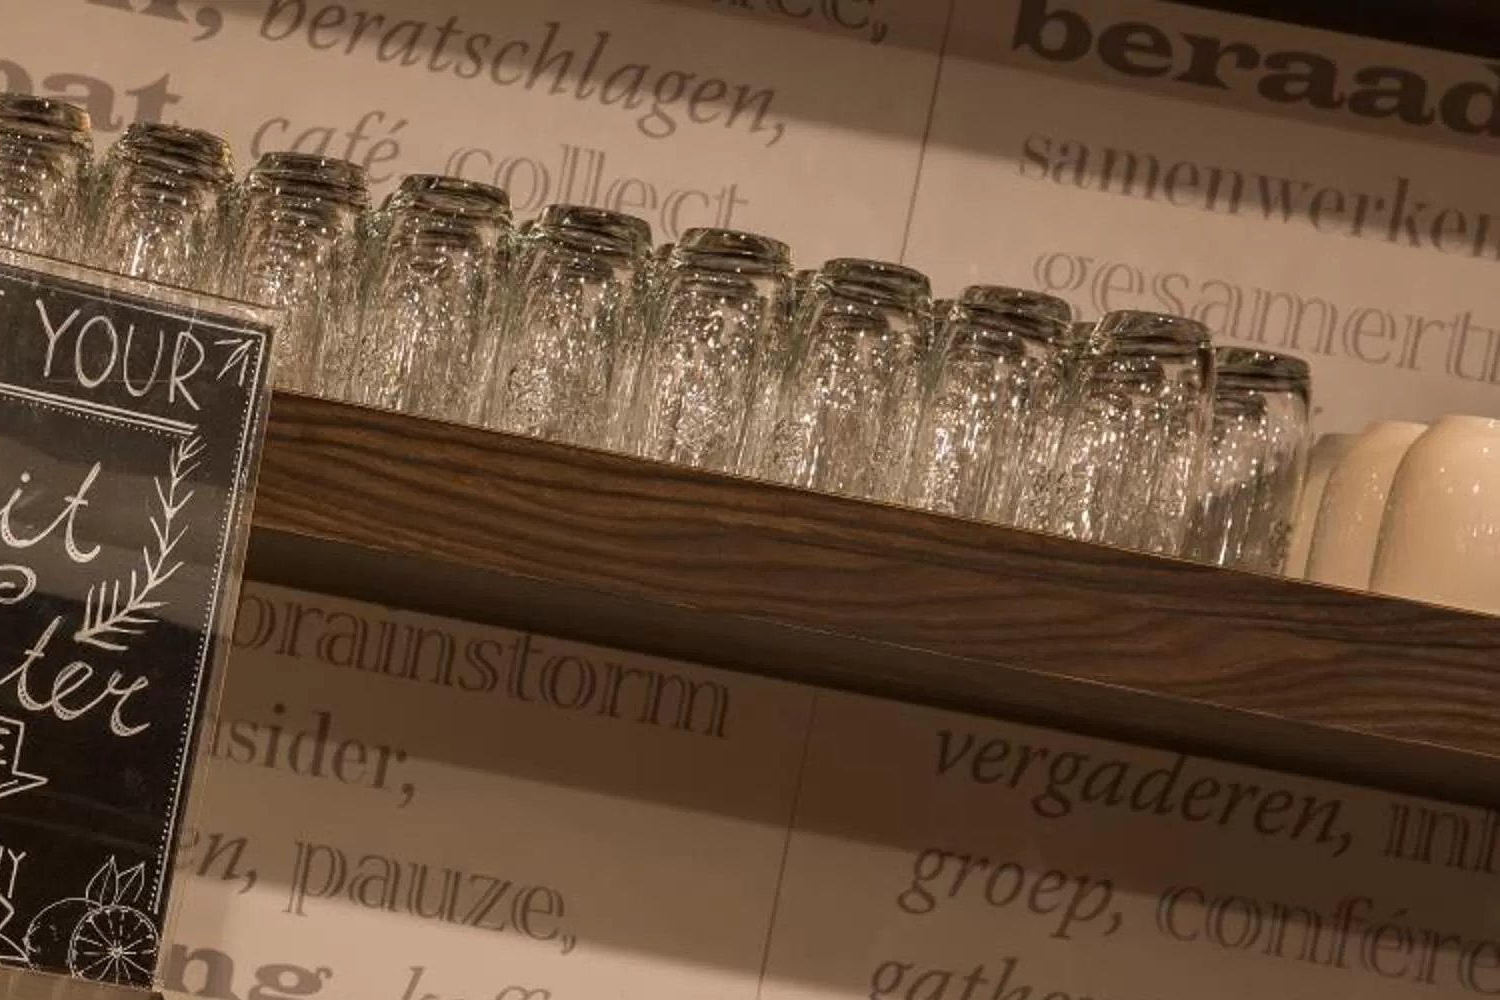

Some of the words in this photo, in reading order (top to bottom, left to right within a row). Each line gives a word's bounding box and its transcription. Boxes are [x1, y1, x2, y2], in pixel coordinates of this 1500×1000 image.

[35, 298, 206, 411] YOUR
[933, 727, 1352, 858] vergaderen,
[280, 834, 579, 955] pauze,
[896, 844, 1124, 940] groep,
